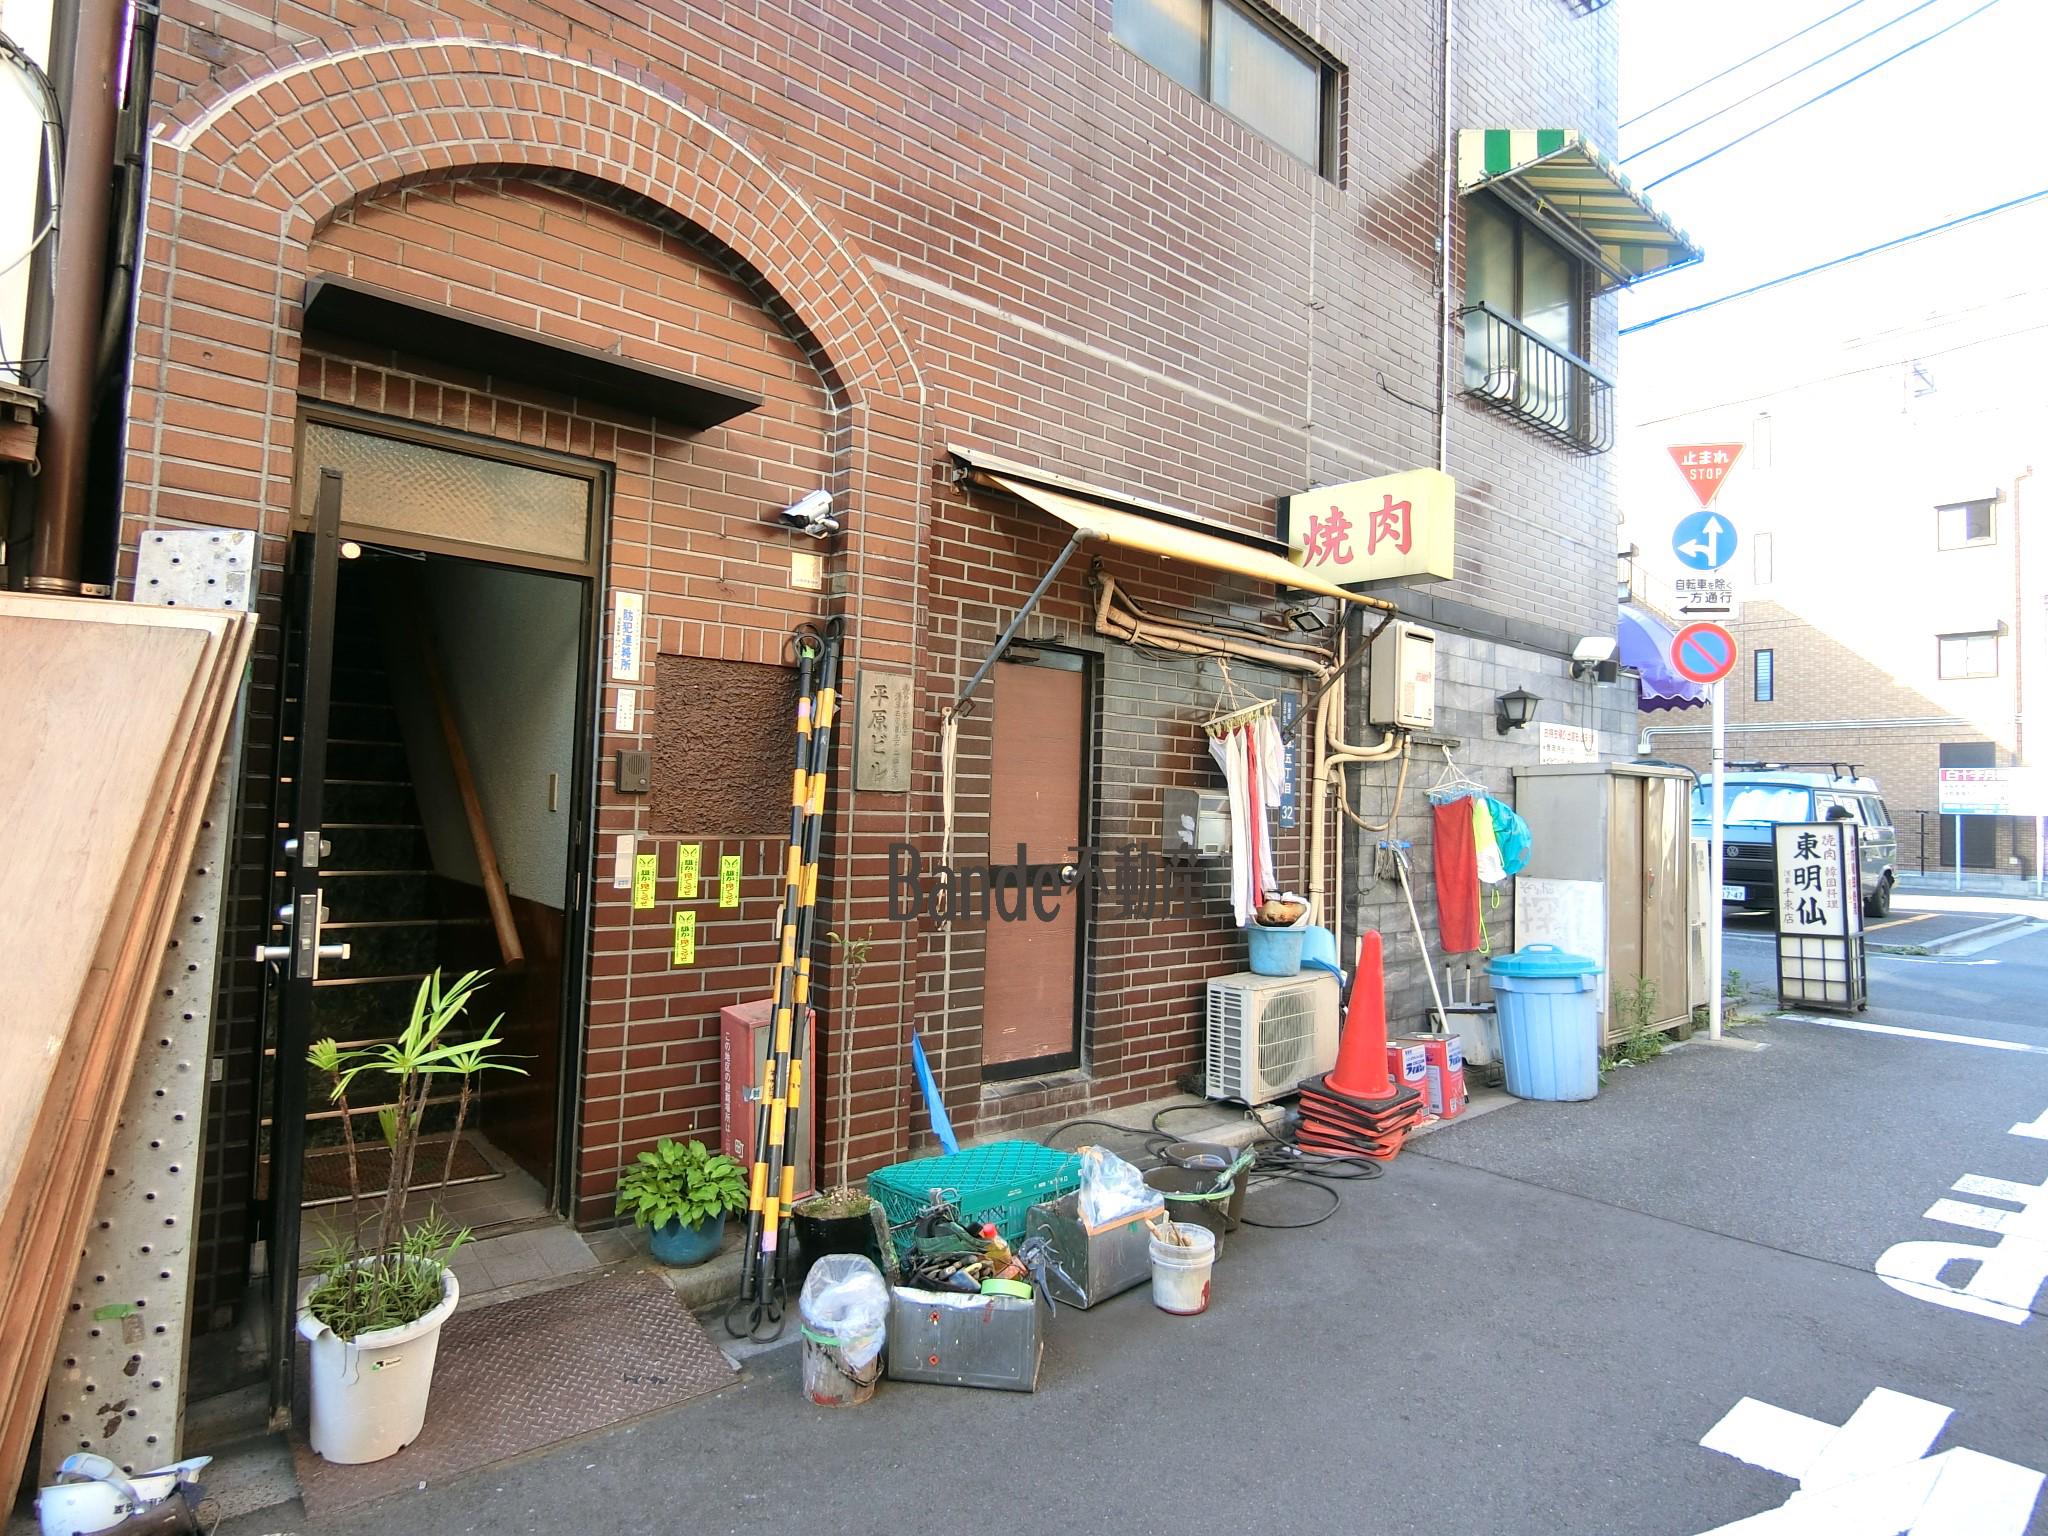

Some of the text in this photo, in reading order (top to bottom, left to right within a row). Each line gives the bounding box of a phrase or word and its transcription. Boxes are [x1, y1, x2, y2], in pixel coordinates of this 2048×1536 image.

[1681, 450, 1729, 466] 止まれ
[1690, 468, 1723, 480] STOP
[1302, 494, 1413, 568] 焼肉
[1675, 579, 1732, 591] 自転車を除く
[1675, 591, 1732, 604] 一方通行
[620, 608, 634, 671] 防犯連絡所
[867, 684, 890, 783] 平原ビル
[1281, 805, 1293, 819] 32
[1793, 832, 1828, 926] 東明仙
